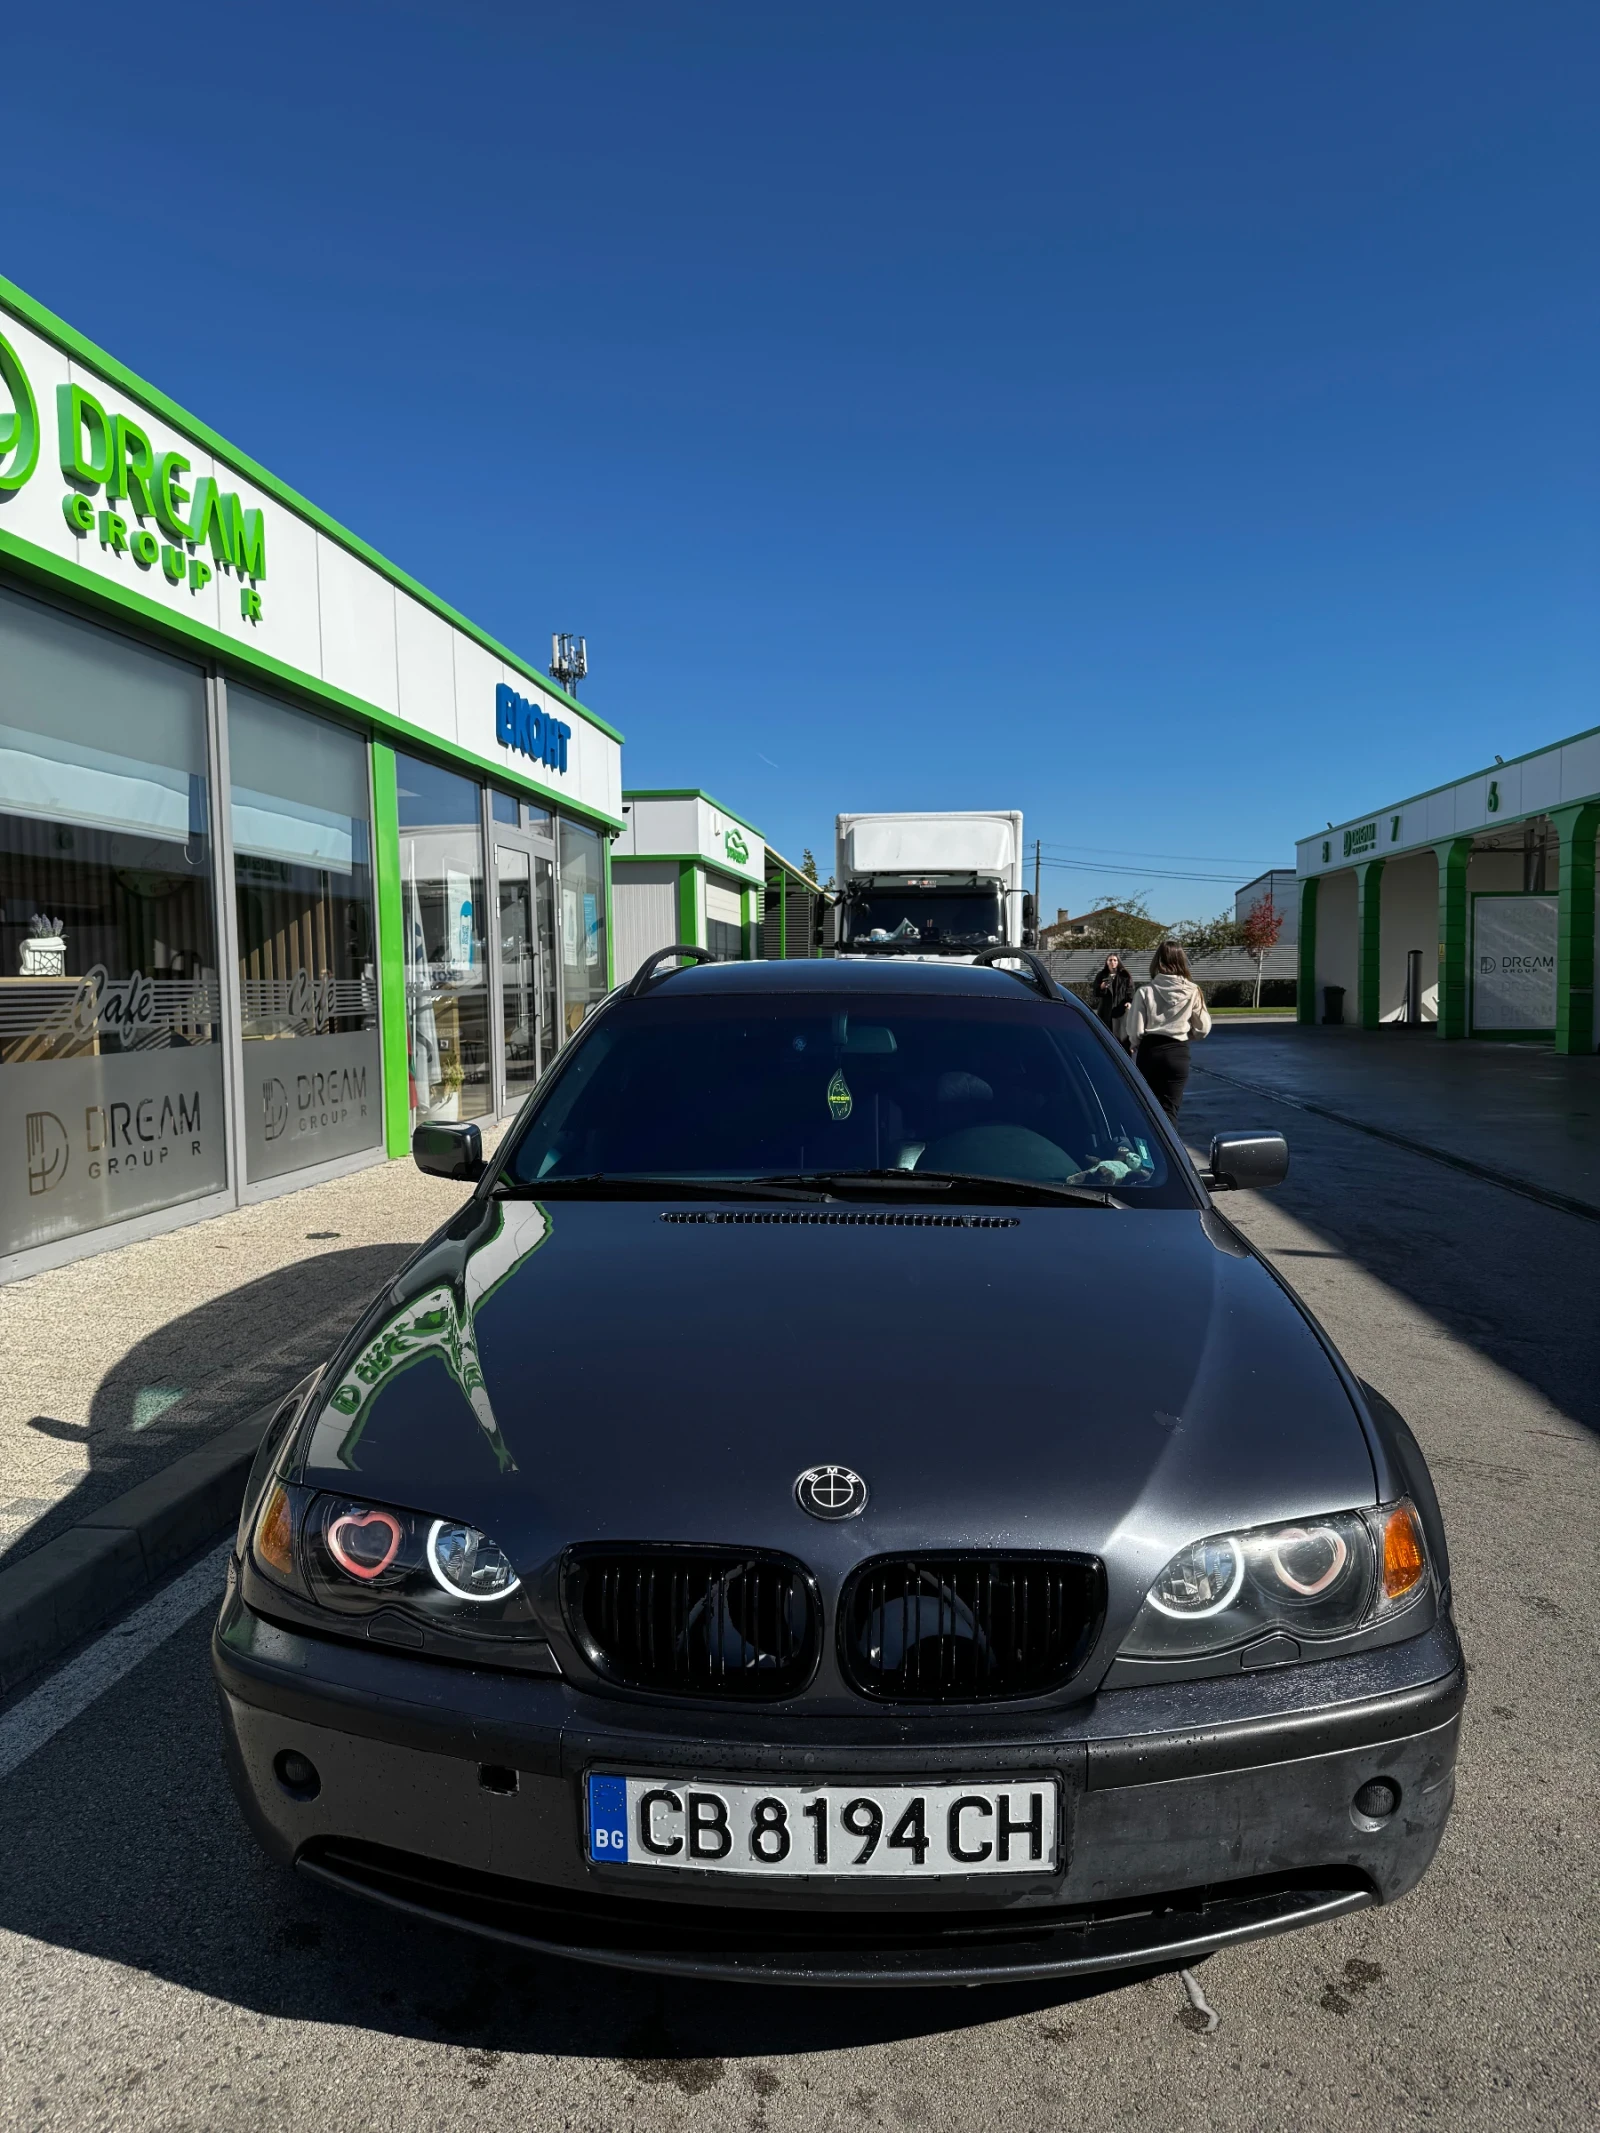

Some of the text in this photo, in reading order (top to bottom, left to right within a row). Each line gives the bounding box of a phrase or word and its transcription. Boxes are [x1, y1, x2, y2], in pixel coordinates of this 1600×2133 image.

[56, 383, 266, 580] DREAM
[62, 494, 263, 621] GROUP R
[1488, 781, 1499, 812] 6
[1352, 823, 1376, 846] DREAM
[1390, 816, 1400, 842] 7
[1502, 957, 1554, 967] DREAM
[72, 965, 154, 1045] Café
[297, 1066, 367, 1110] DREAM
[86, 1091, 201, 1152] DREAM
[299, 1104, 367, 1131] GROUP R
[88, 1140, 201, 1179] GROUP R
[806, 1467, 859, 1483] BMW
[595, 1827, 624, 1849] BG
[640, 1789, 1043, 1865] CB 8194 CH
